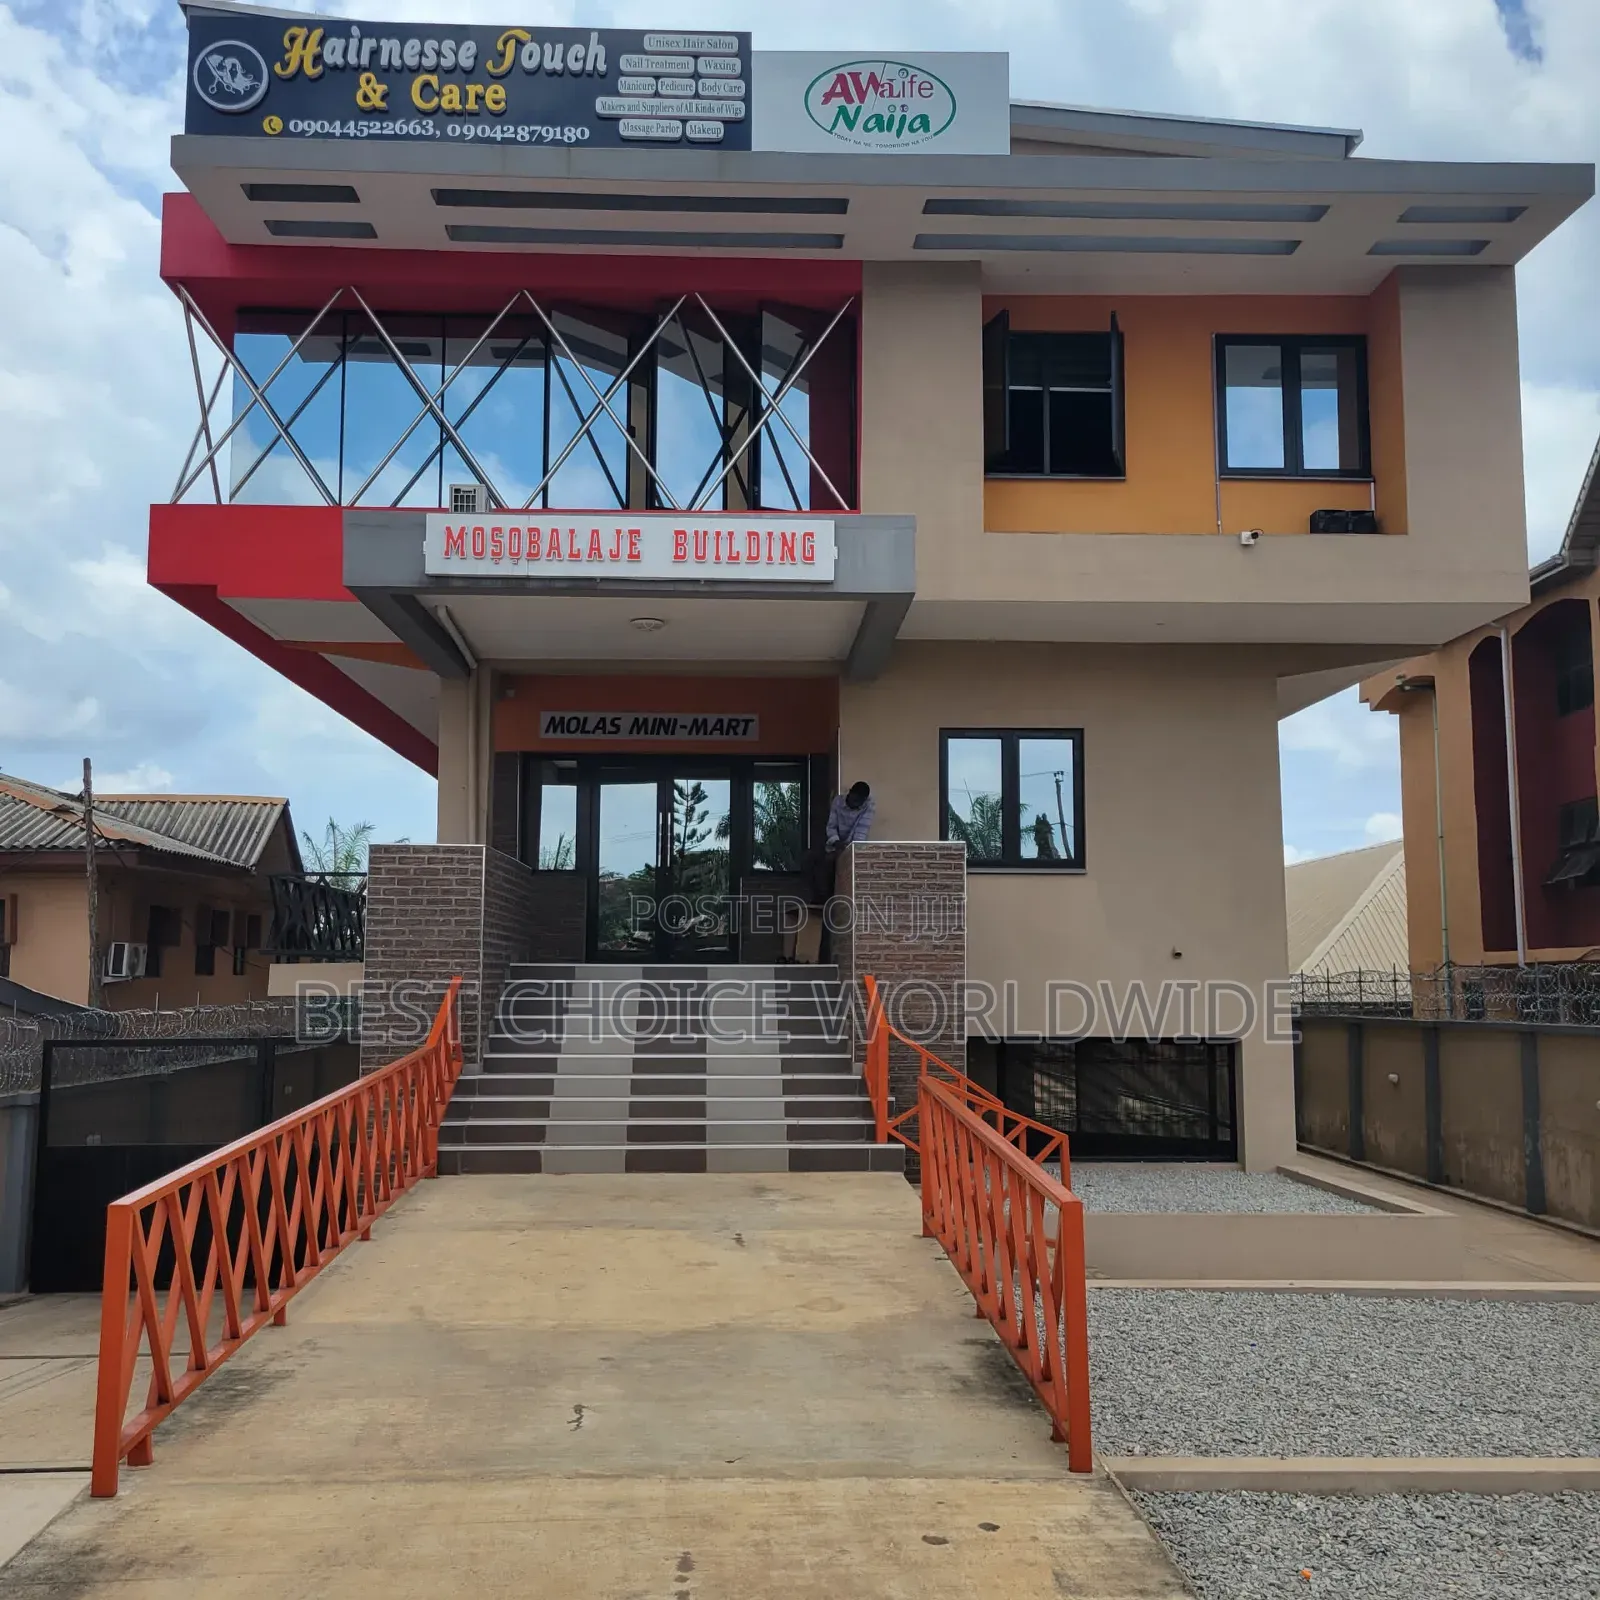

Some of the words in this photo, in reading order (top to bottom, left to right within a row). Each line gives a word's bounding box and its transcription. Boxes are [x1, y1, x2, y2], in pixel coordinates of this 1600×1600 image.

[648, 36, 681, 49] Unisex
[683, 37, 705, 49] Hair
[707, 38, 734, 50] Salon
[274, 26, 477, 79] Hairnesse
[486, 29, 607, 77] Touch
[625, 58, 643, 69] Nail
[645, 58, 690, 70] Treatment
[704, 59, 737, 73] Waxing
[356, 72, 388, 111] &
[411, 74, 507, 113] Care
[619, 80, 656, 91] Manicure
[660, 81, 694, 92] Pedicure
[702, 82, 721, 95] Body
[723, 83, 742, 93] Care
[600, 101, 626, 112] Makers
[627, 101, 640, 112] and
[642, 102, 675, 115] Suppliers
[677, 103, 684, 113] of
[684, 103, 694, 113] All
[695, 103, 716, 114] Kinds
[716, 103, 725, 114] of
[725, 104, 743, 118] Wigs
[622, 122, 655, 135] Massage
[656, 123, 680, 134] Parlor
[830, 104, 931, 139] Naija
[289, 119, 441, 138] 09044522663,
[447, 124, 590, 143] 09042879180
[689, 124, 722, 138] Makeup
[672, 529, 817, 564] BUILDING
[545, 716, 622, 736] MOLAS
[628, 717, 755, 737] MINI-MART
